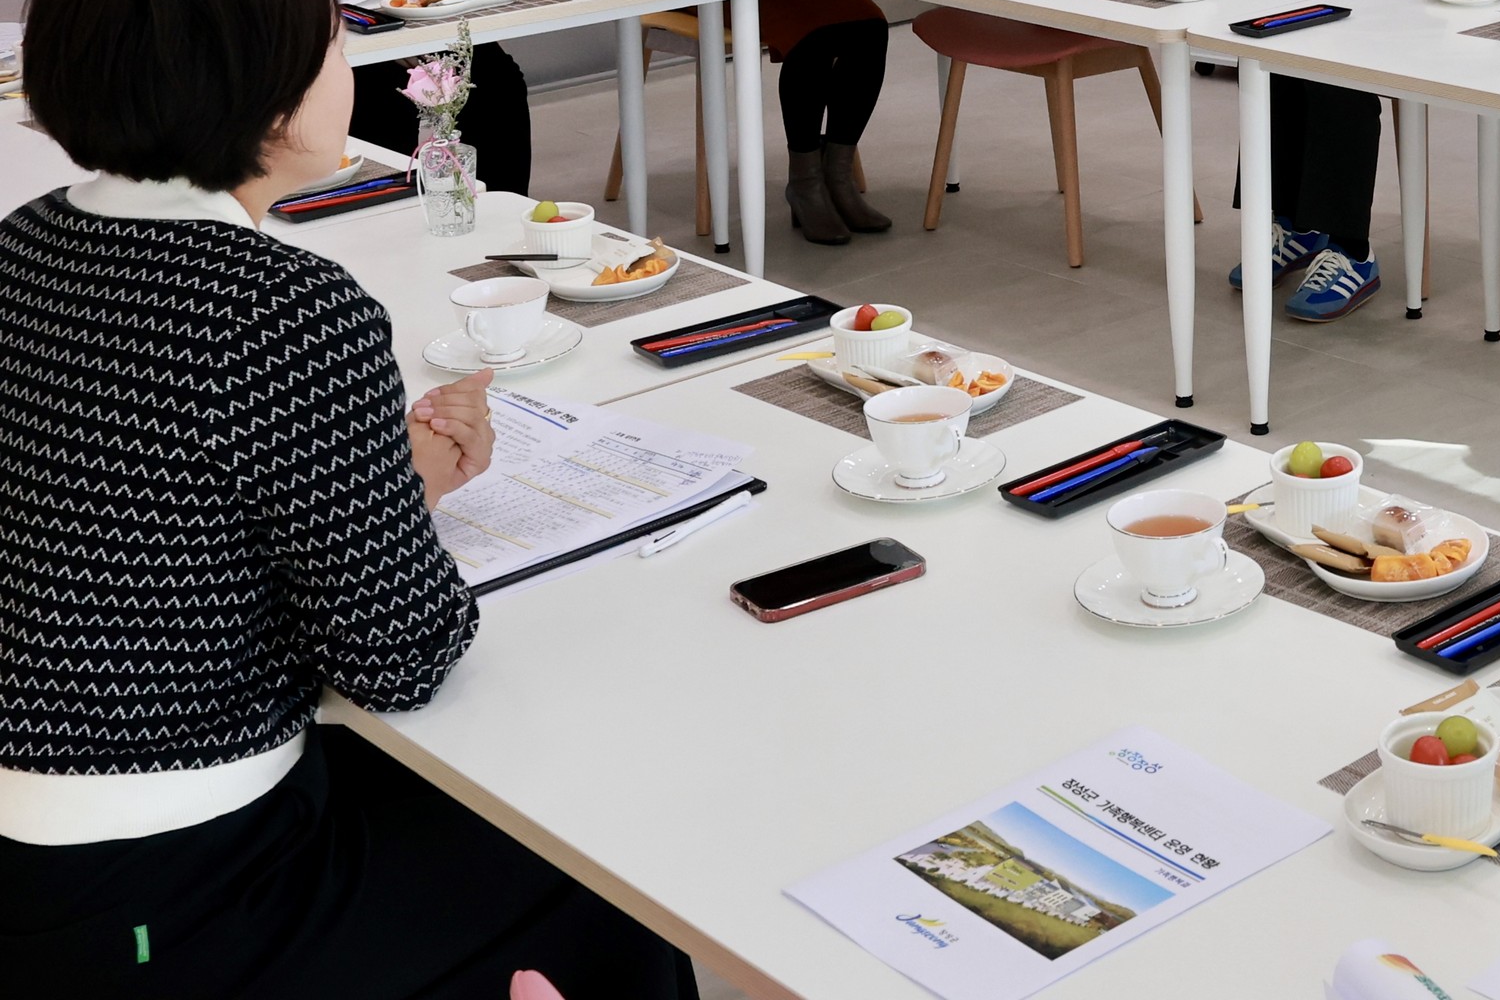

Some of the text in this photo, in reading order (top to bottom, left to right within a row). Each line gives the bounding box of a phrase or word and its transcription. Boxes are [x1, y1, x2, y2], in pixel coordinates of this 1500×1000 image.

[1062, 778, 1220, 870] 장성군 가족행복센터 운영 현황
